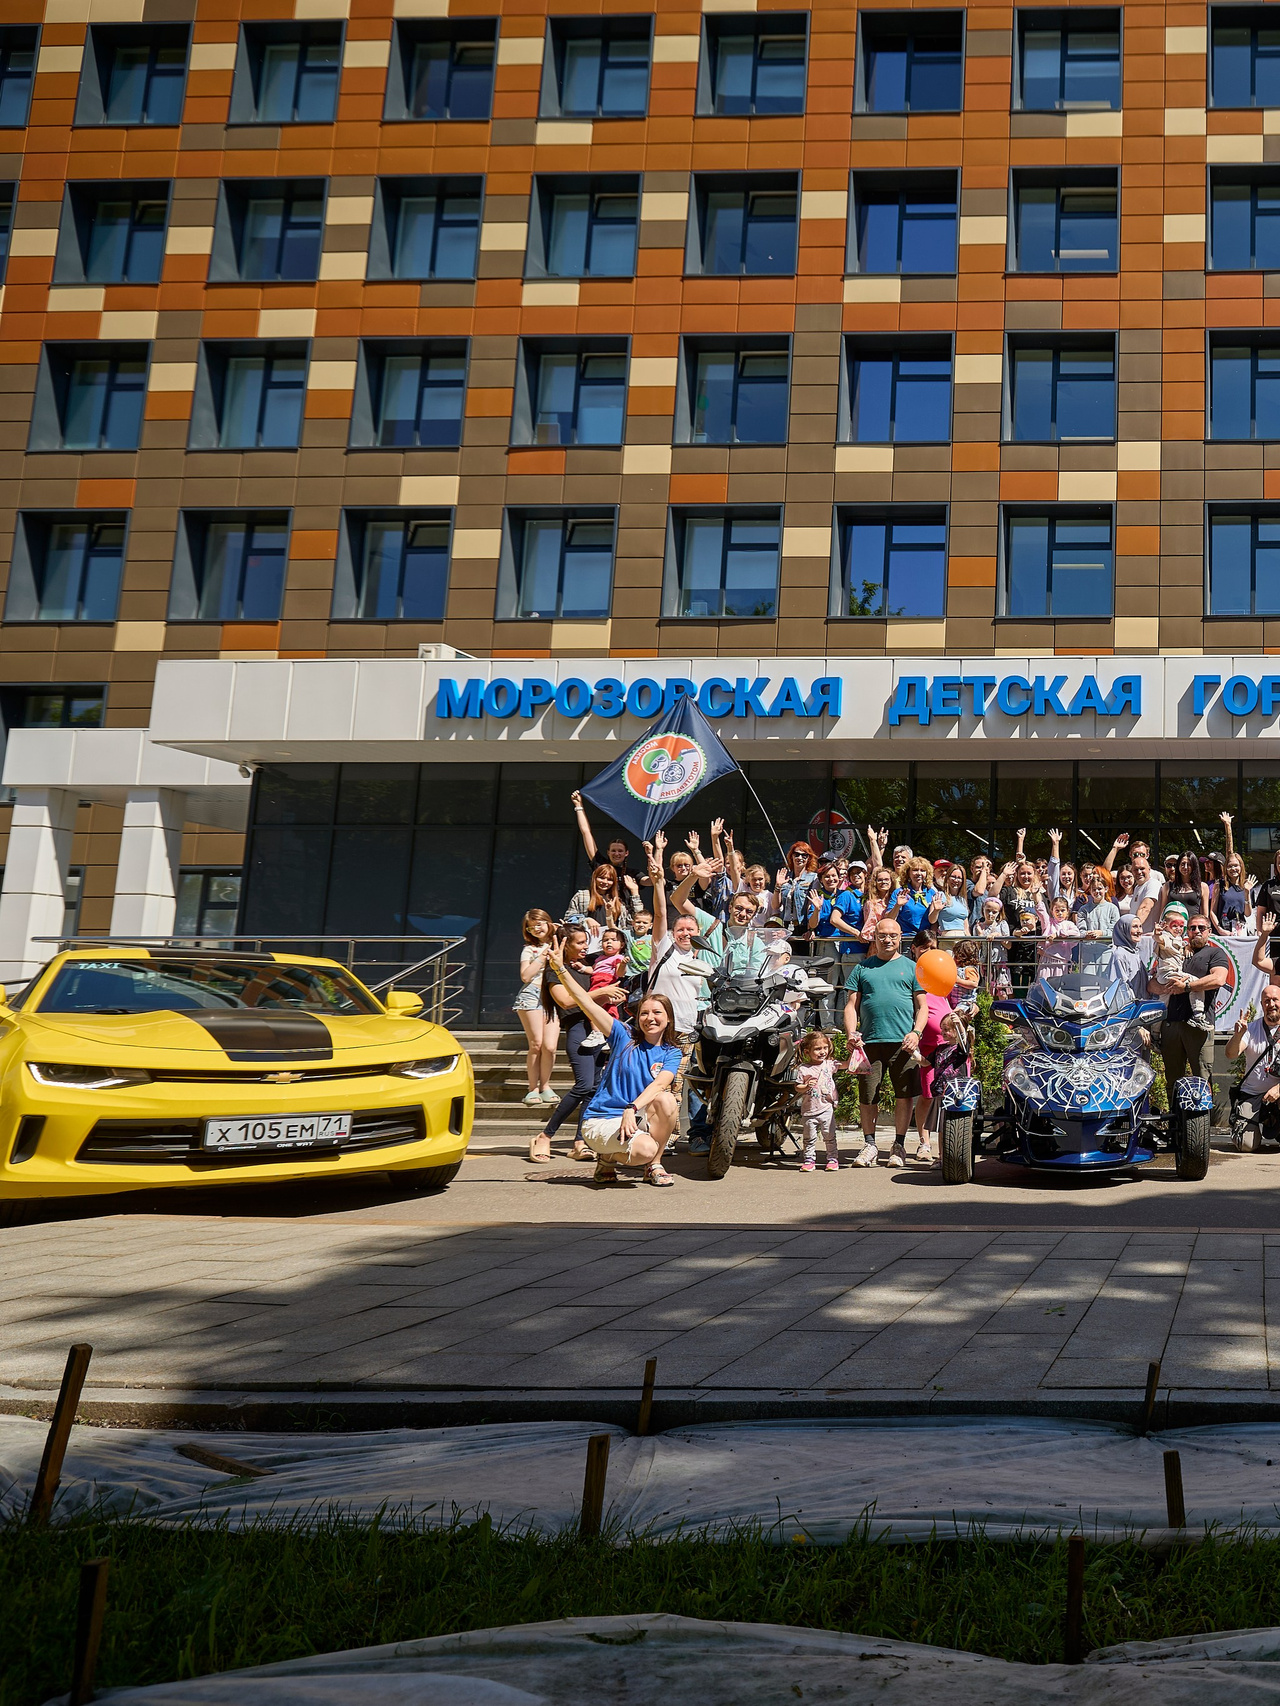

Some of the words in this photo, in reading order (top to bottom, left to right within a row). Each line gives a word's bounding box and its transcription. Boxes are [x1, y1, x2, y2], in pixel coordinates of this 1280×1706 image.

[889, 676, 1142, 725] ДЕТСКАЯ
[78, 962, 121, 970] TAXI
[321, 1116, 343, 1131] 71
